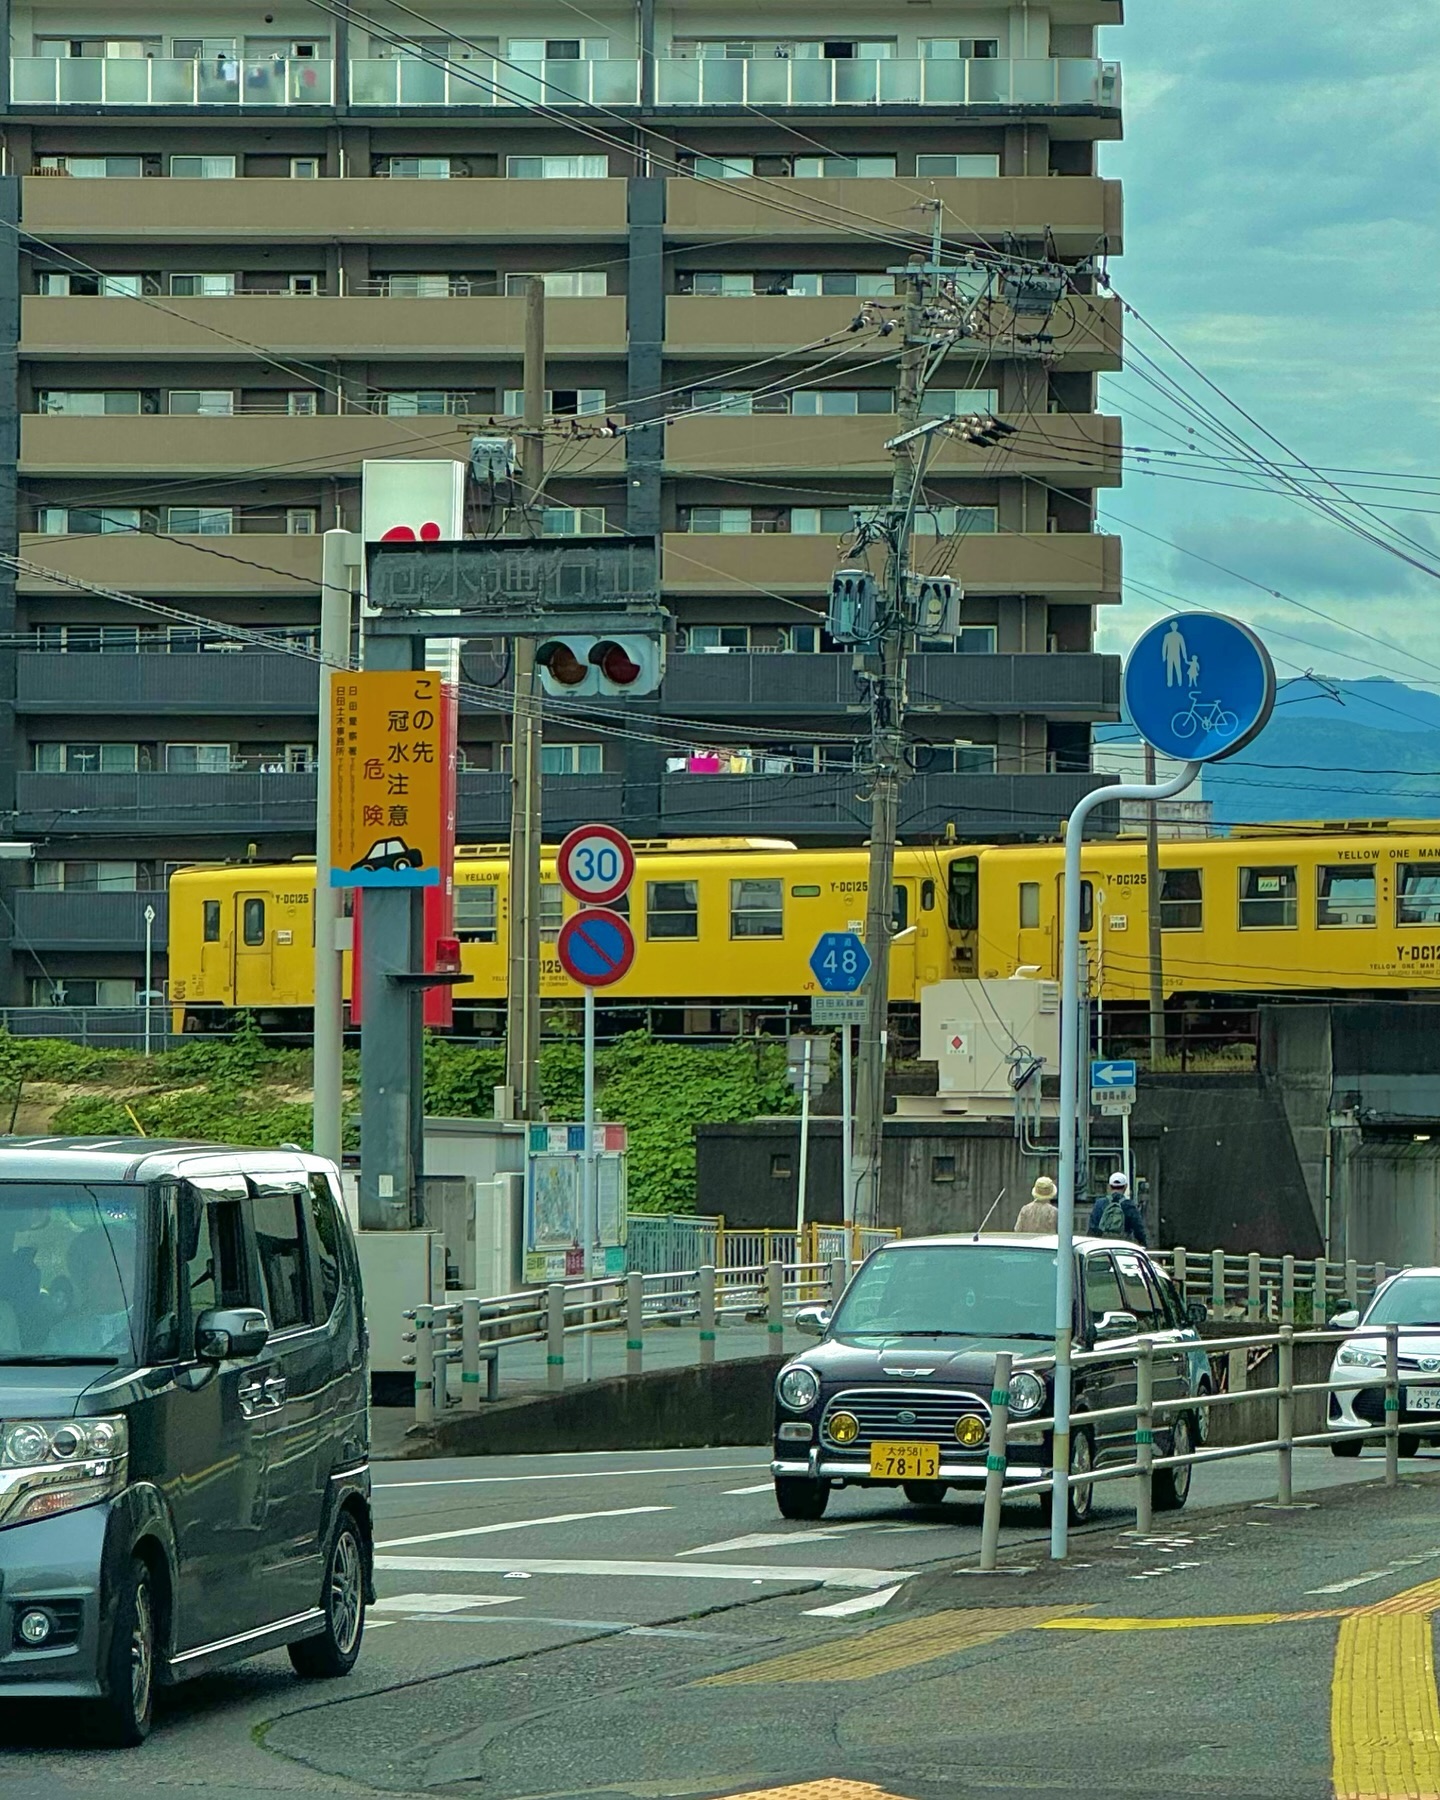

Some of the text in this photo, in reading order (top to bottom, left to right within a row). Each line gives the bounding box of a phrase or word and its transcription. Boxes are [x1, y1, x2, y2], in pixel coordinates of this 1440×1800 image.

[412, 679, 434, 763] この先
[387, 710, 409, 827] 冠水注意
[363, 758, 385, 827] 危険
[1337, 850, 1380, 860] YELLOW
[1389, 850, 1410, 858] ONE
[575, 848, 618, 882] 30
[465, 873, 500, 881] YELLOW
[1106, 874, 1147, 886] Y-DC125
[830, 881, 868, 892] Y-DC125
[275, 893, 309, 904] Y-DC125
[539, 960, 562, 973] 125
[823, 950, 857, 973] 48
[803, 982, 814, 990] JR
[886, 1458, 934, 1476] 78-13
